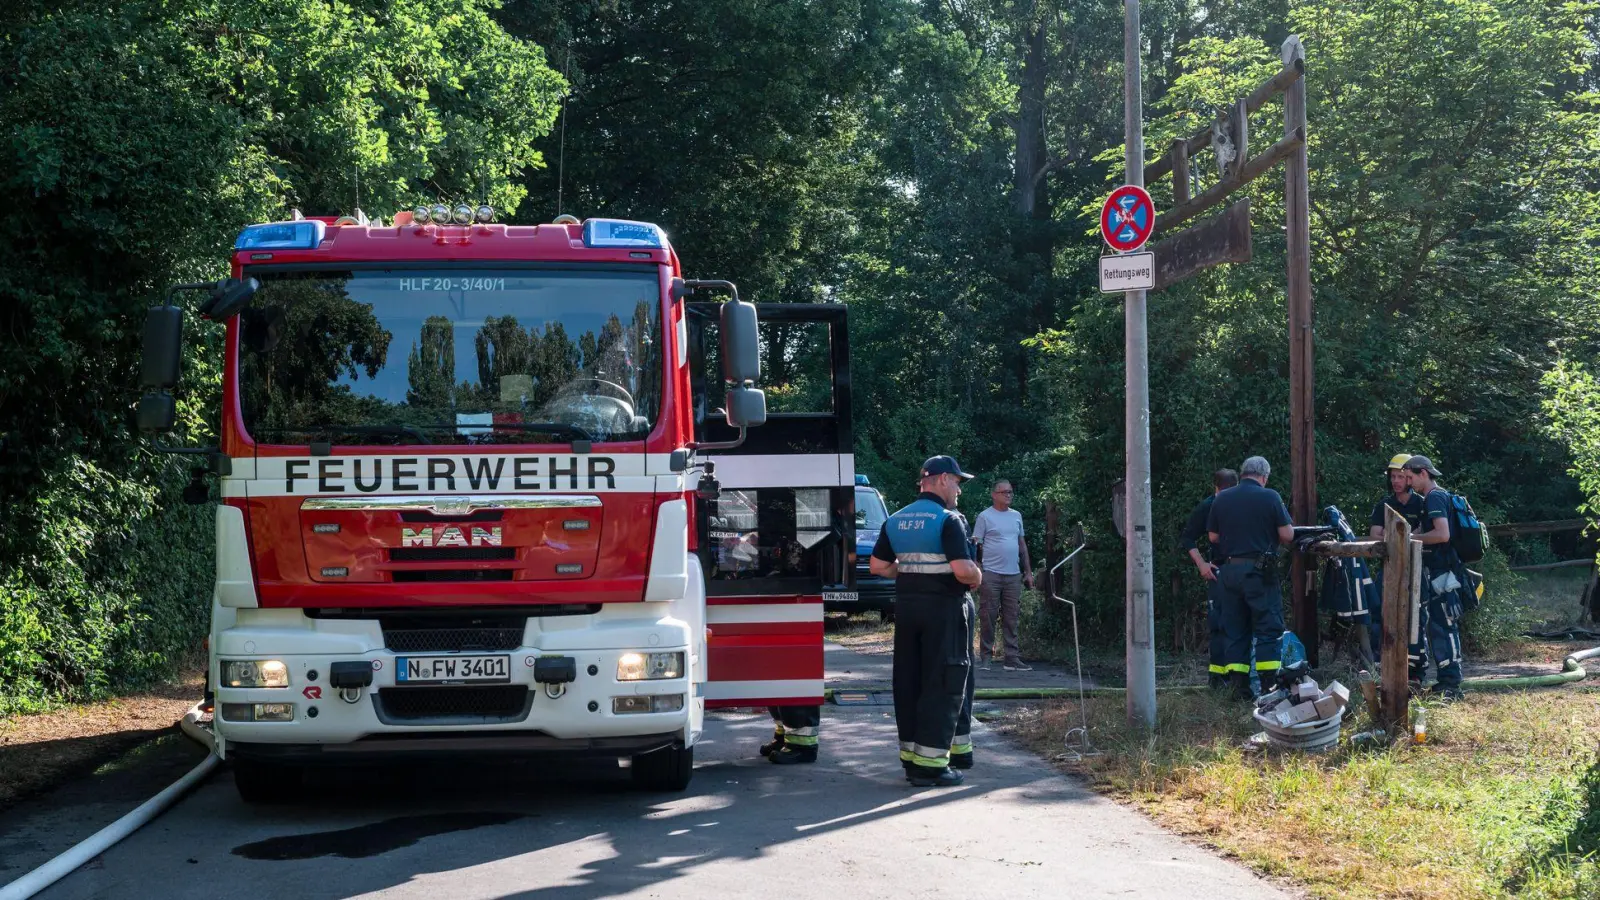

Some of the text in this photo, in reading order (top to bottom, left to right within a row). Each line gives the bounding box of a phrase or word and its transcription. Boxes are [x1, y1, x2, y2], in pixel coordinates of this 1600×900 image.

[1104, 268, 1150, 280] Rettungsweg
[399, 278, 431, 291] HLF
[285, 456, 616, 493] FEUERWEHR
[898, 520, 925, 530] HLF 3/1
[402, 526, 502, 547] MAN
[408, 658, 507, 678] N FW 3401
